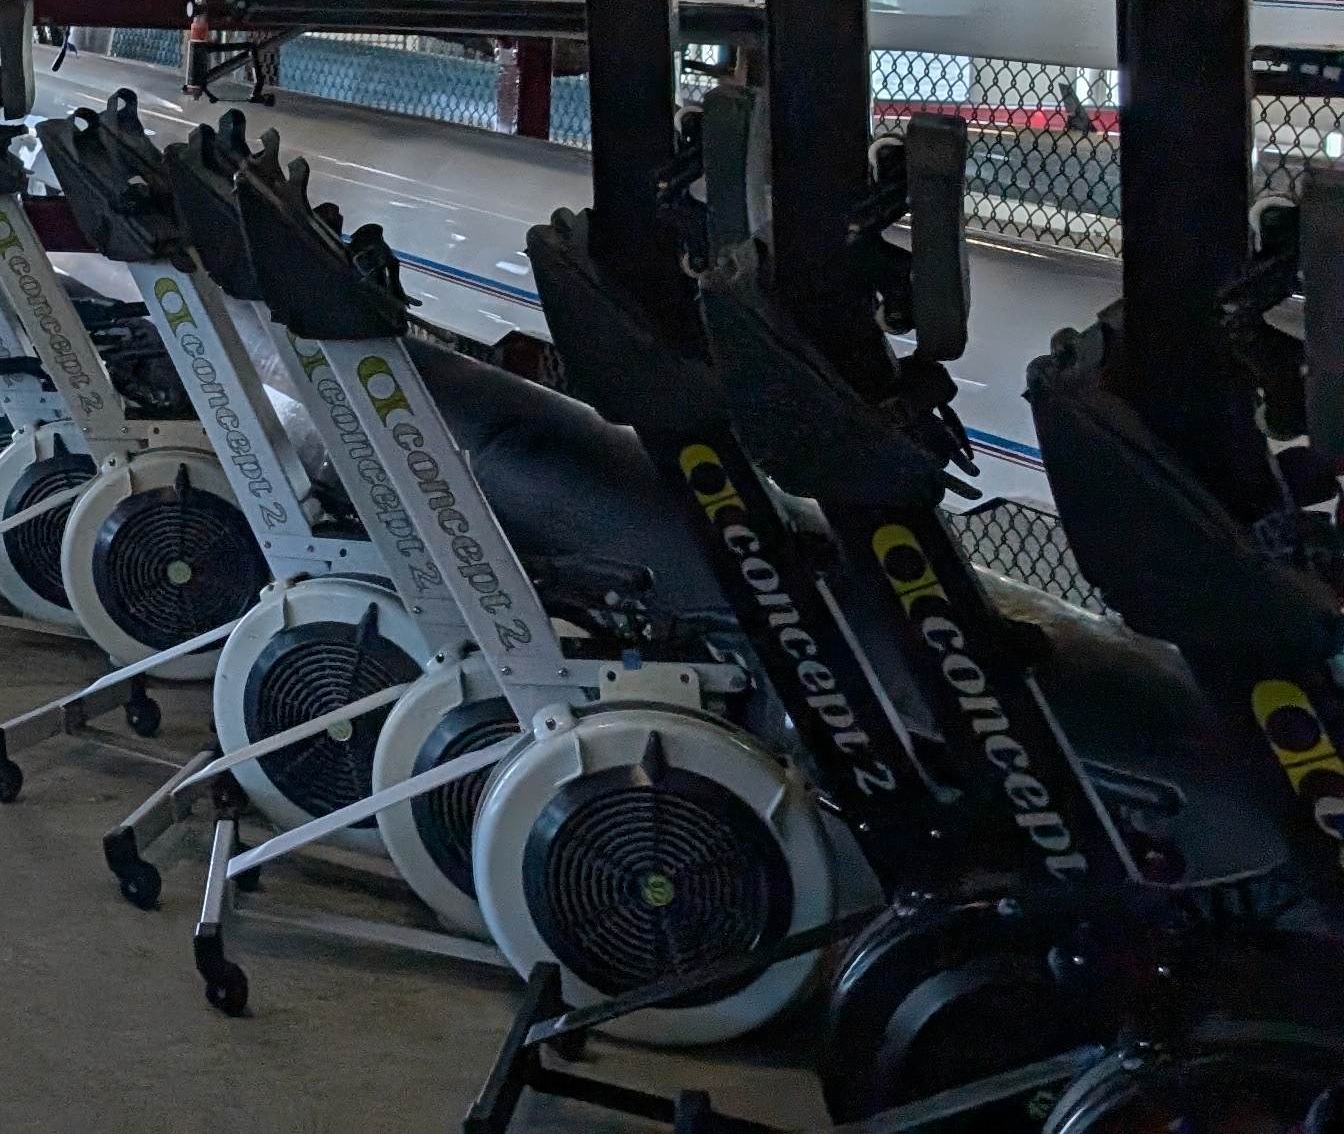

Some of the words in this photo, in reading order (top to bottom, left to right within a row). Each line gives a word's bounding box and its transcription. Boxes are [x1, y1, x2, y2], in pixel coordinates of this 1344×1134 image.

[8, 254, 91, 390] concept
[77, 390, 105, 416] 2
[180, 333, 273, 499] concept
[259, 501, 289, 530] 2
[316, 377, 426, 558] concept
[408, 561, 443, 593] 2
[391, 422, 512, 616] concept
[494, 618, 533, 653] 2
[723, 523, 870, 754] concept
[852, 759, 897, 797] 2
[921, 615, 1089, 880] concept
